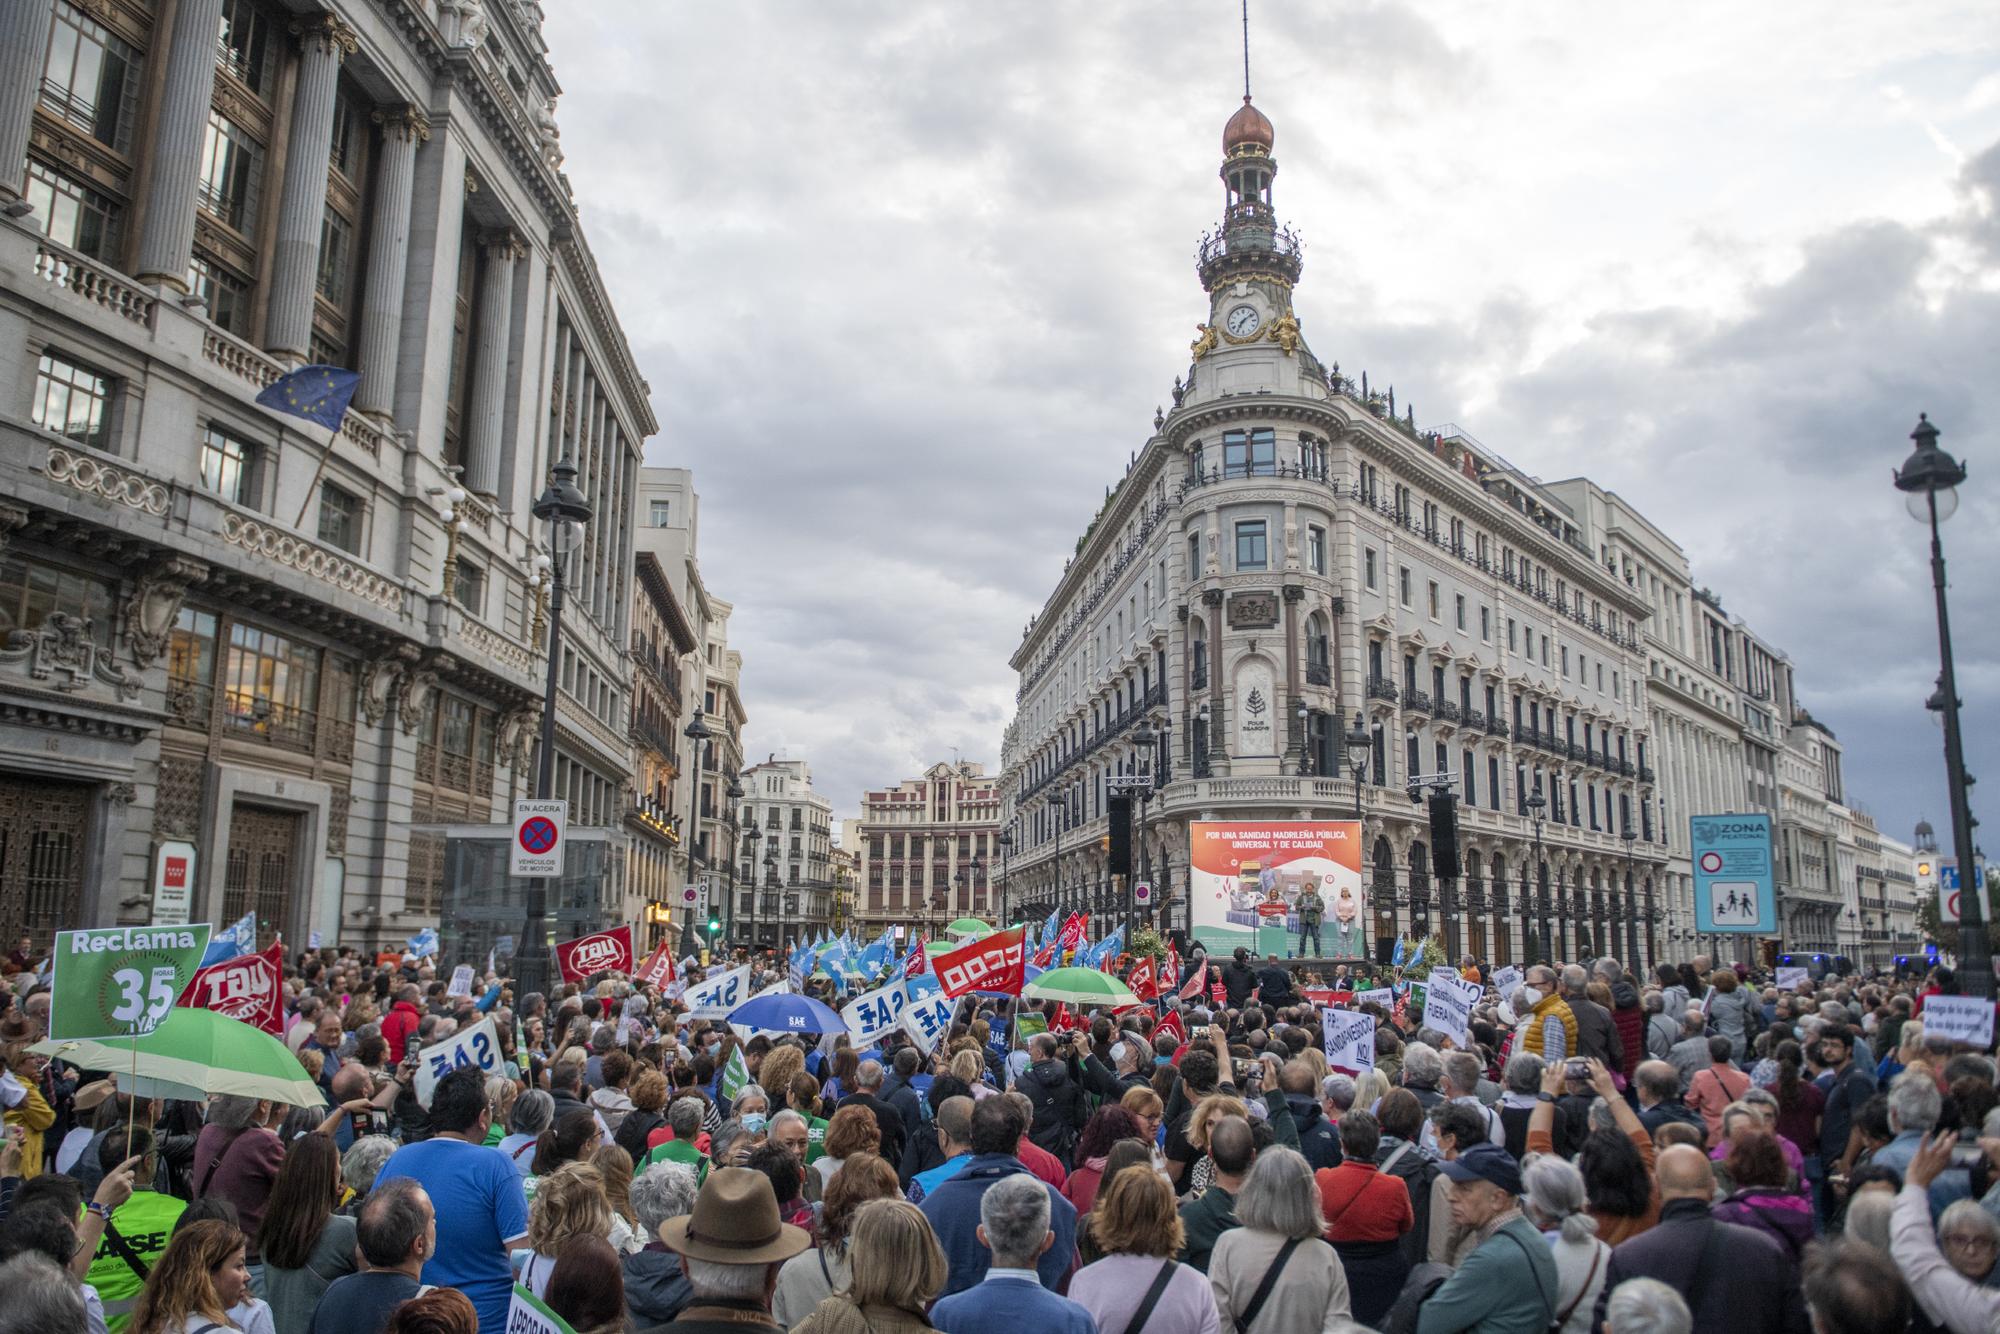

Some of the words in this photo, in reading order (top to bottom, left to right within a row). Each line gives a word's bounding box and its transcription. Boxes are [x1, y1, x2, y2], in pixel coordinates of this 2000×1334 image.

[46, 737, 59, 752] 16
[519, 804, 530, 812] EN
[532, 804, 561, 812] ACERA
[1205, 831, 1220, 840] POR
[1222, 831, 1237, 840] UNA
[1238, 831, 1271, 840] SANIDAD
[1273, 829, 1314, 840] MADRILEÑA
[1316, 829, 1348, 840] PÚBLICA,
[1721, 823, 1766, 833] ZONA
[1232, 841, 1270, 849] UNIVERSAL
[1273, 841, 1278, 849] Y
[1280, 841, 1290, 849] DE
[1292, 841, 1323, 849] CALIDAD
[700, 876, 708, 918] HOTEL
[71, 929, 196, 954] Reclama
[112, 967, 174, 1022] 35
